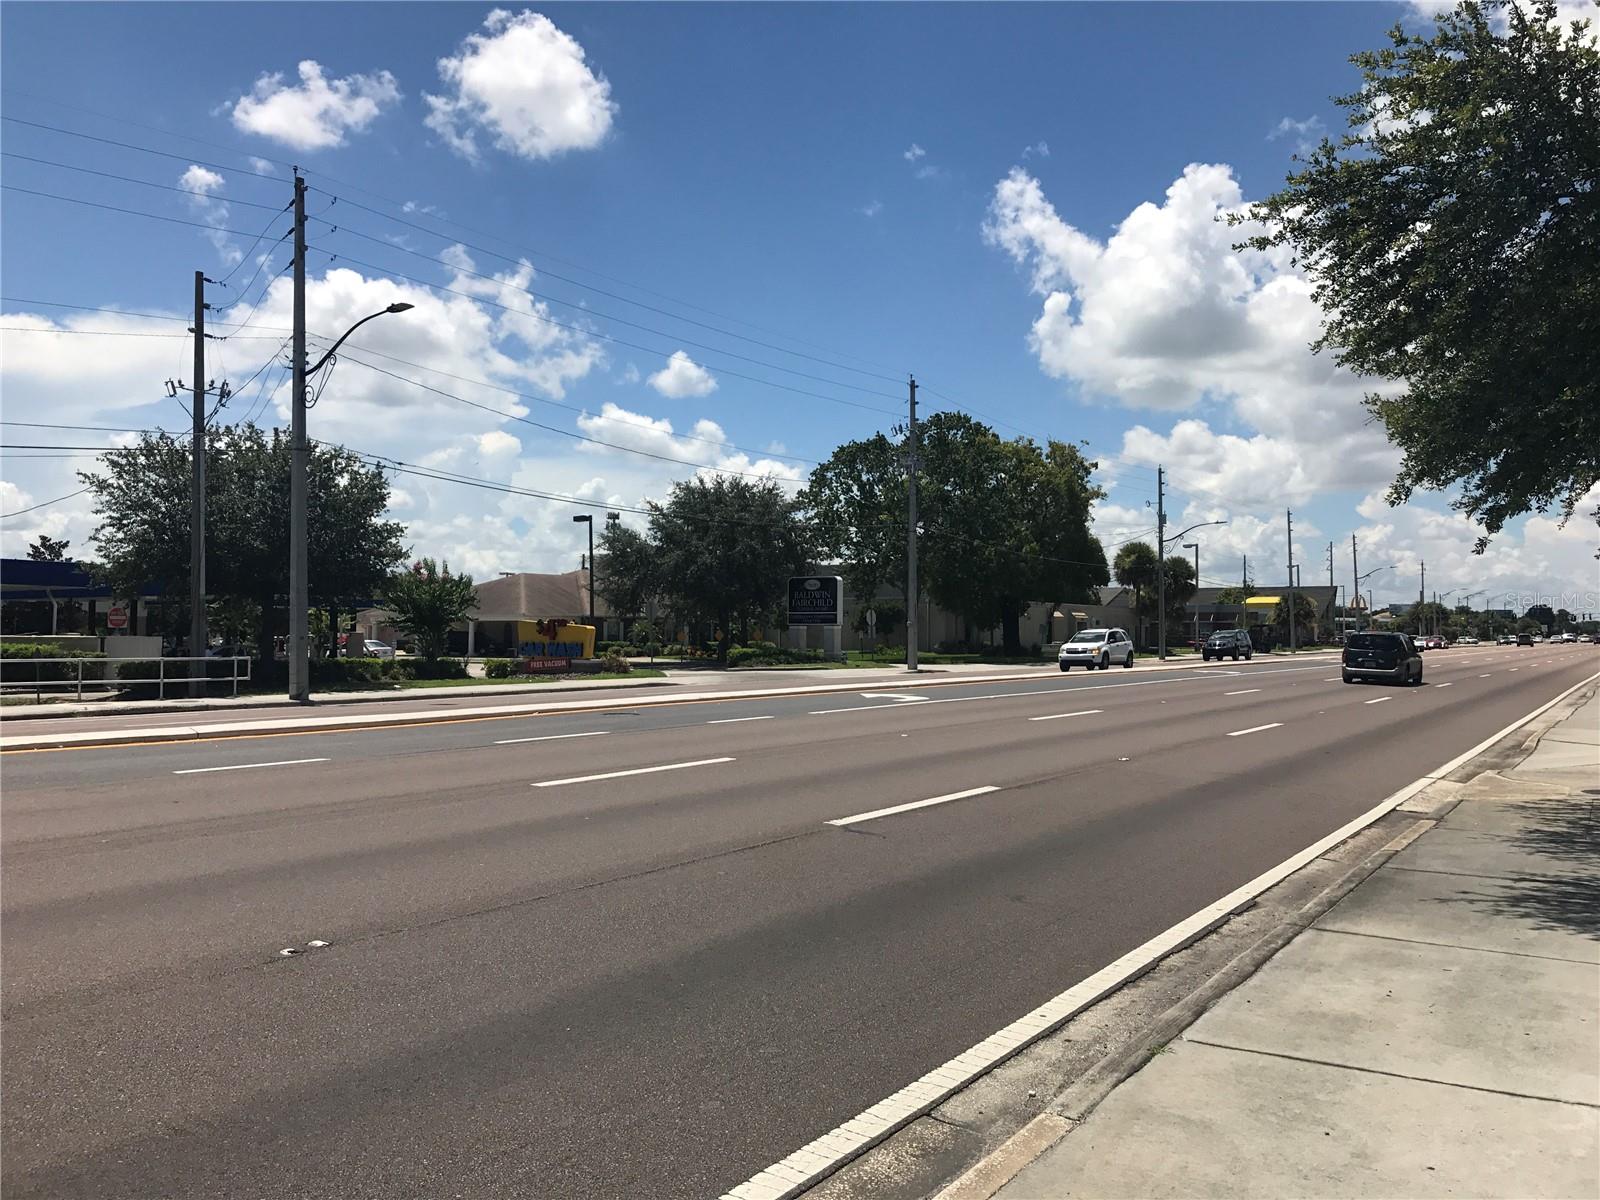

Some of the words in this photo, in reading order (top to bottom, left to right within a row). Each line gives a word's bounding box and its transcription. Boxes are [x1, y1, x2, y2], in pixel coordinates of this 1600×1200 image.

[794, 591, 831, 599] BALDWIN
[792, 599, 833, 607] FAIRCHILD
[544, 659, 567, 668] VACUUM
